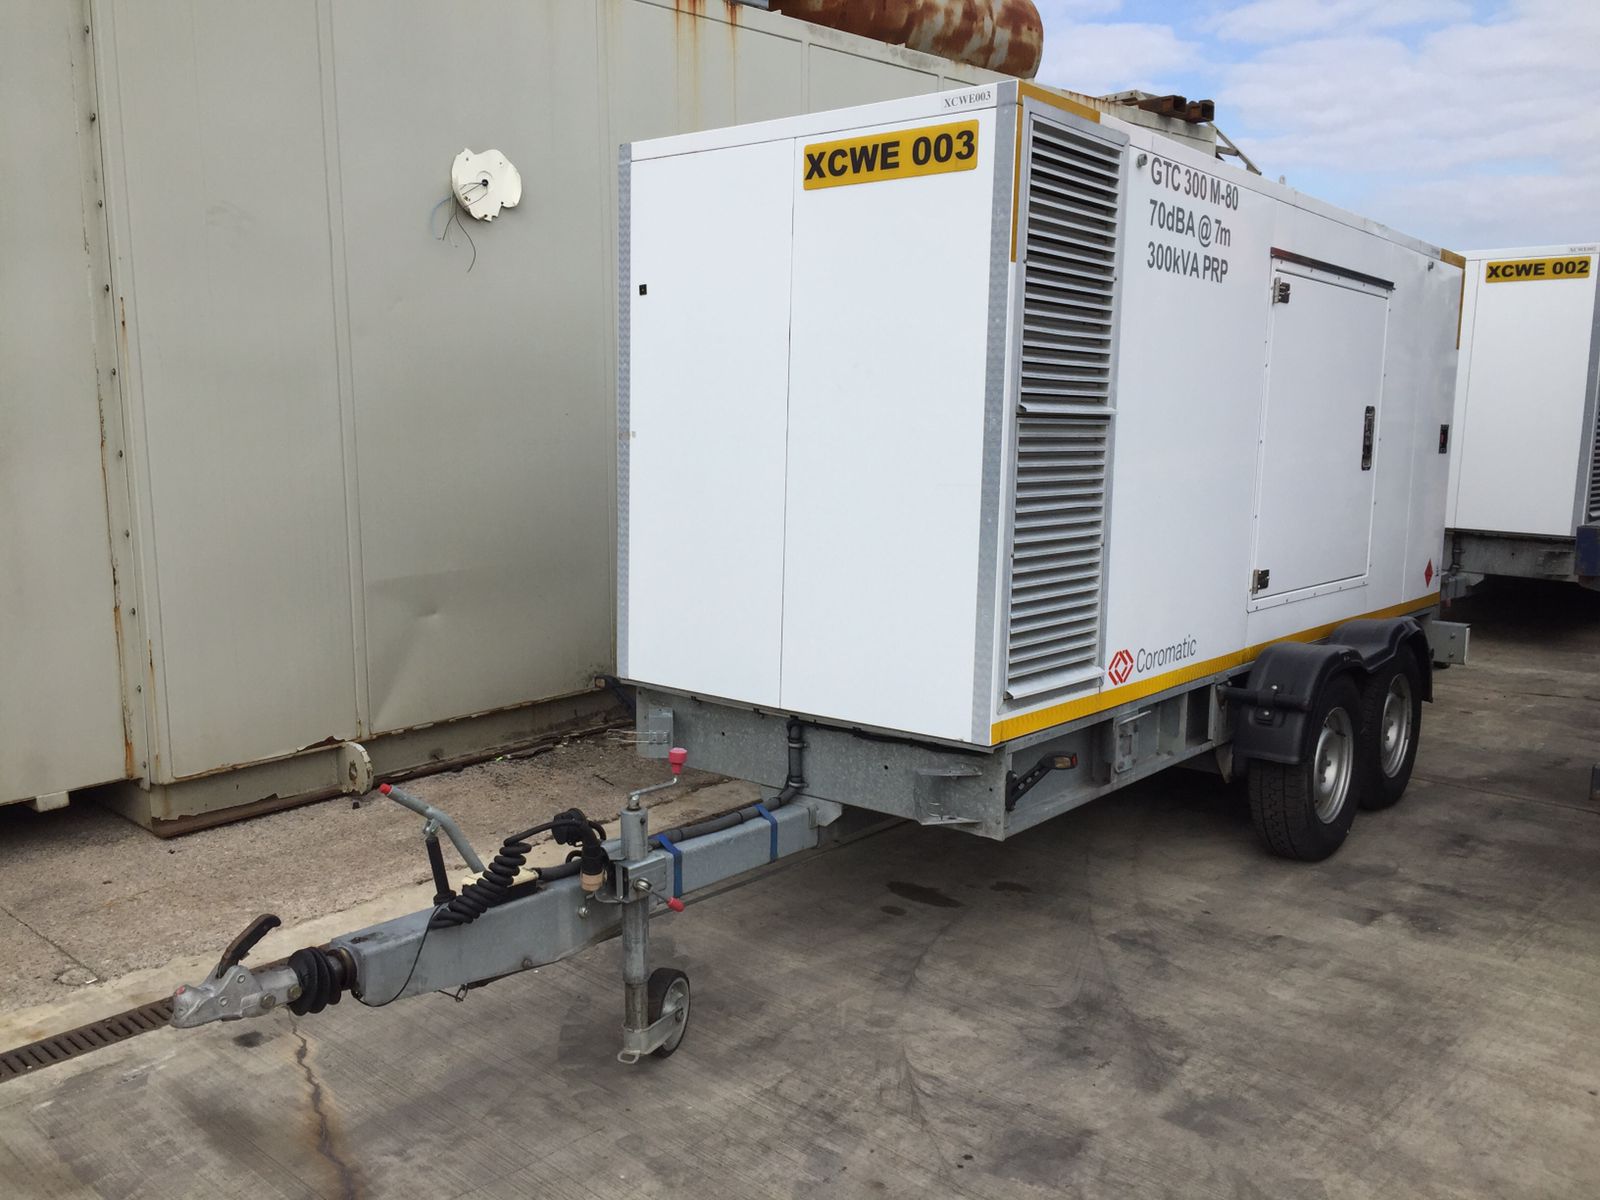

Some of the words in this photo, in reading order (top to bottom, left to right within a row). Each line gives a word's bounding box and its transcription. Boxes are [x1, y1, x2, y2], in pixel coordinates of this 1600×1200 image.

[944, 90, 992, 108] XCWE003
[804, 141, 901, 180] XCWE
[912, 130, 975, 166] 003
[1151, 157, 1181, 192] GTC
[1184, 169, 1207, 200] 300
[1210, 178, 1239, 211] M-80
[1149, 199, 1195, 238] 70dBA
[1198, 214, 1212, 248] @
[1215, 218, 1231, 247] 7m
[1147, 241, 1199, 279] 300kVA
[1202, 255, 1228, 284] PRP
[1487, 263, 1545, 278] XCWE
[1552, 260, 1589, 275] 002
[1136, 634, 1197, 673] Coromatic
